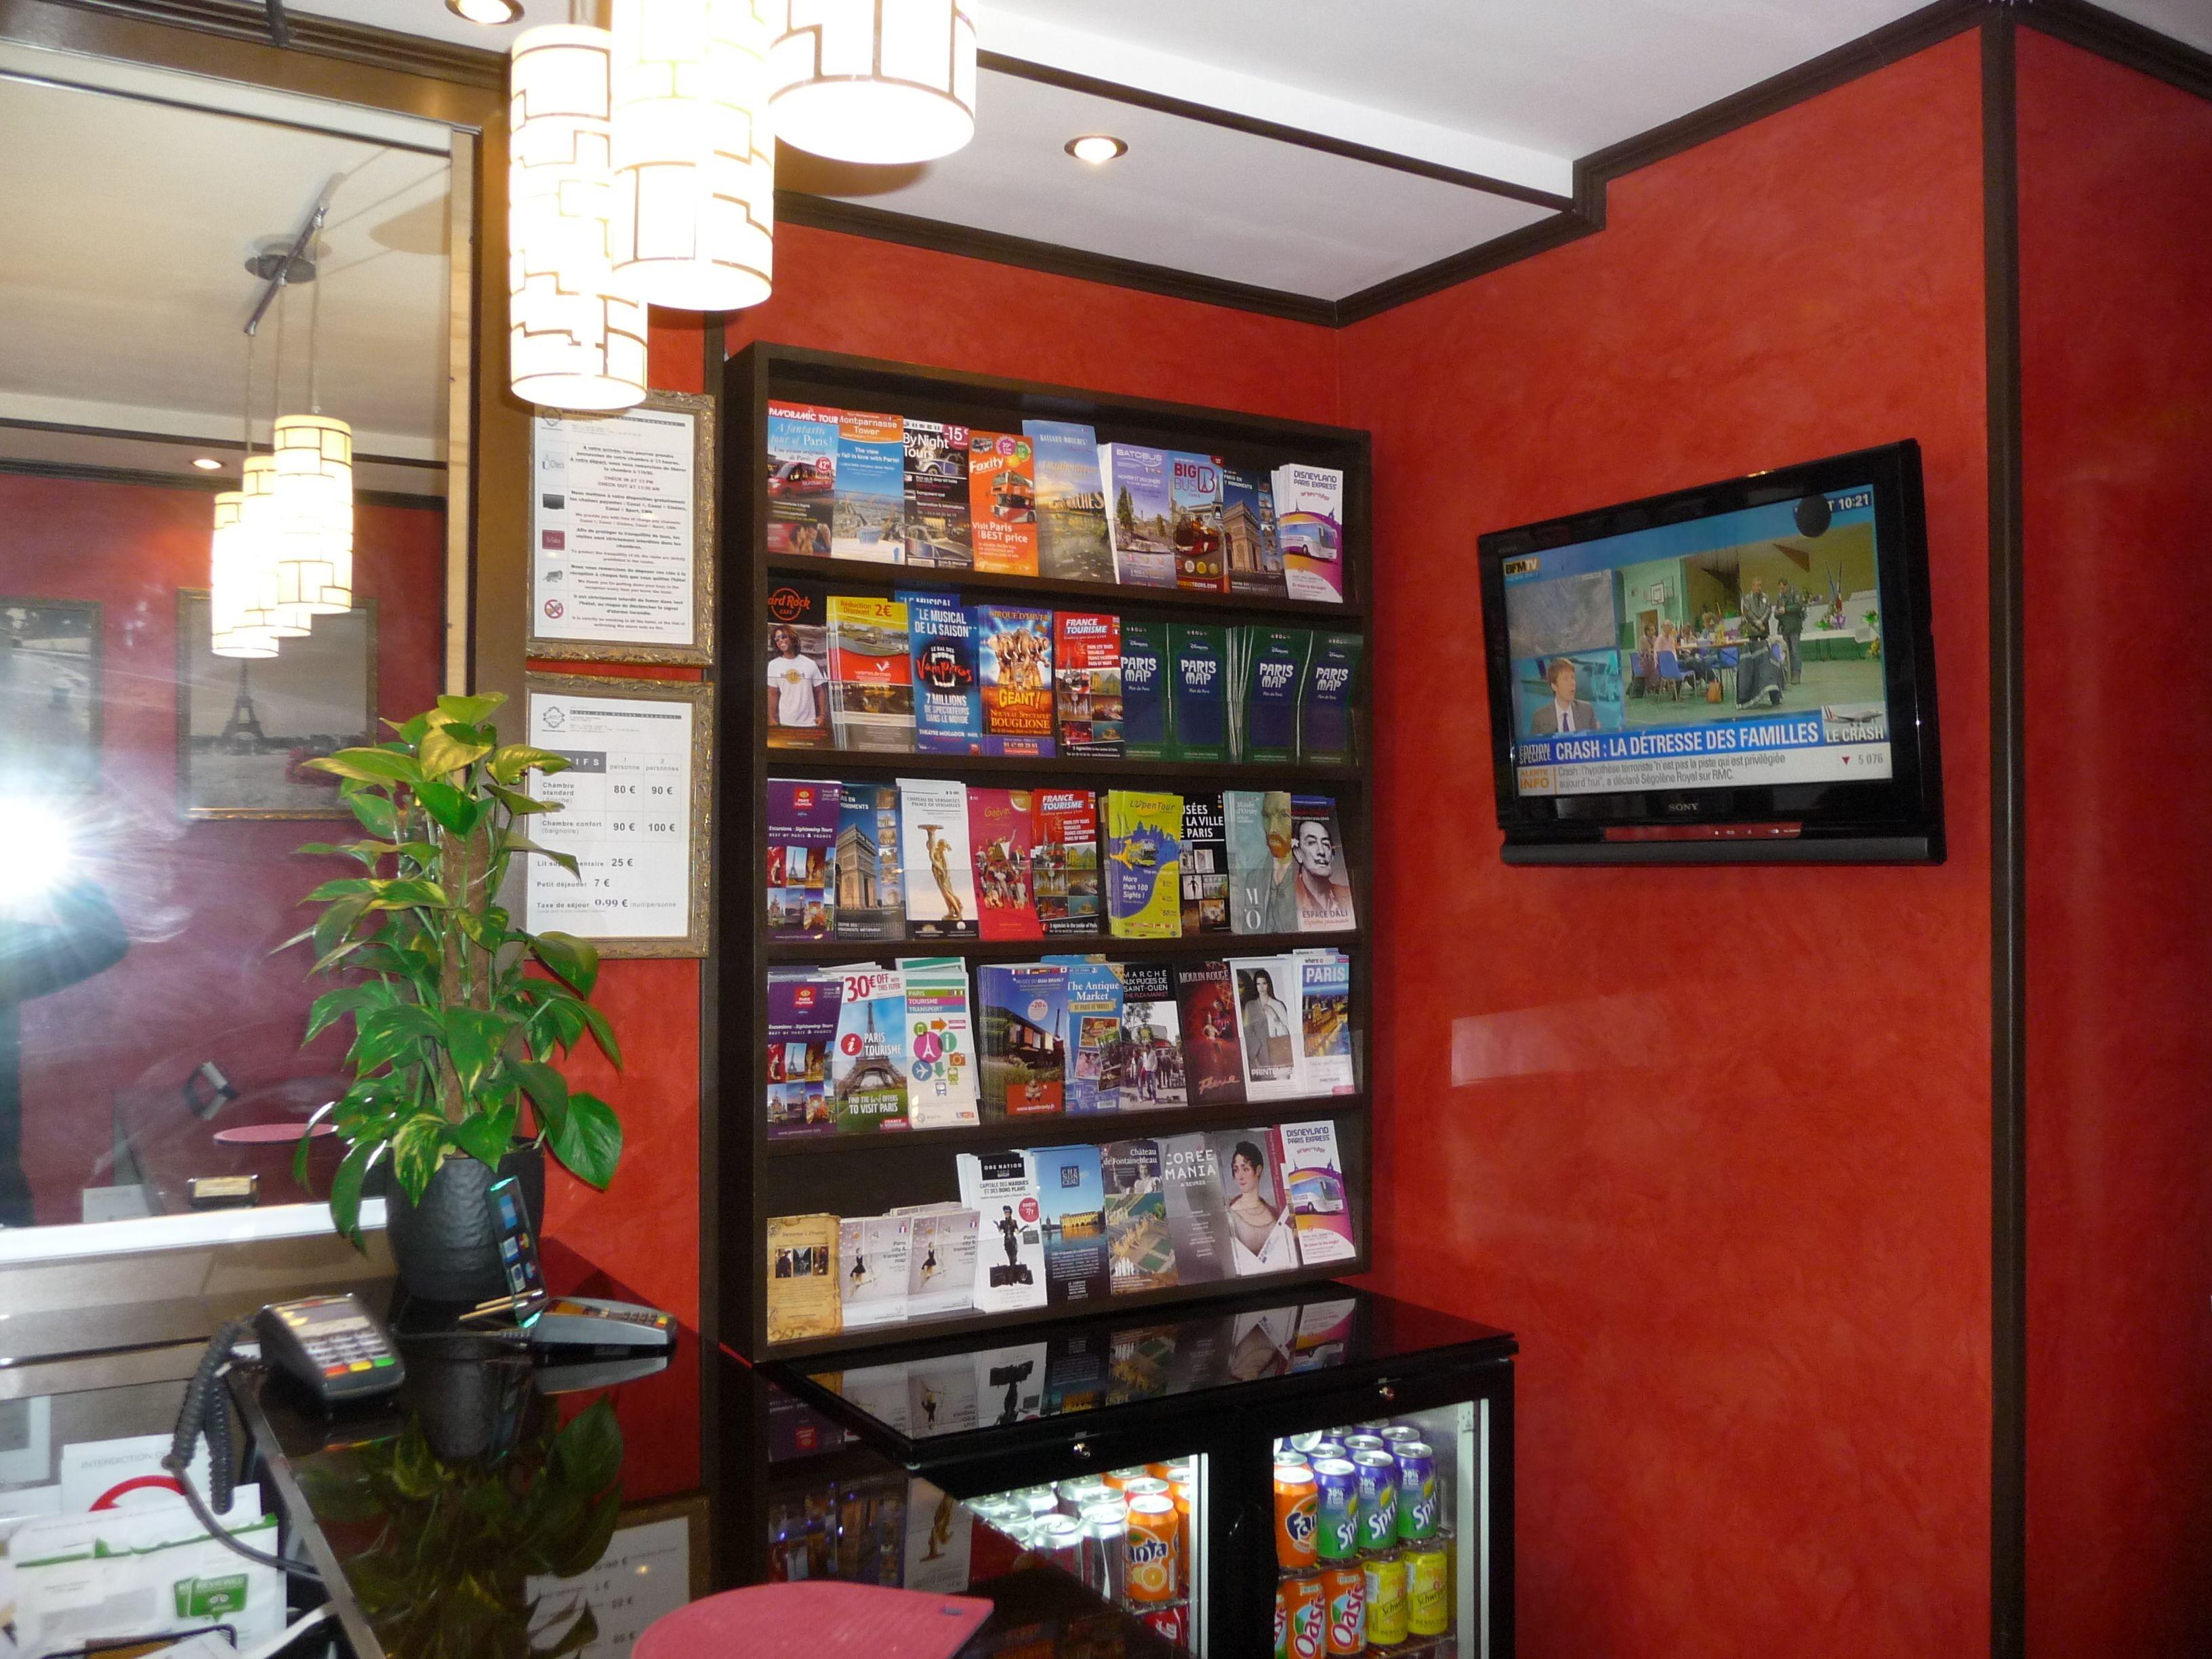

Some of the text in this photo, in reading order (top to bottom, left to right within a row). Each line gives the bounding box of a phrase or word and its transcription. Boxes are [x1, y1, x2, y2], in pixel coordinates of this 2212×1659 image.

[769, 407, 816, 421] PANORAMIC
[819, 414, 839, 424] TOUR
[786, 425, 825, 436] fantastic
[854, 426, 880, 435] Tower
[771, 434, 827, 447] tour Paris
[903, 432, 917, 448] By
[918, 434, 949, 449] Night
[904, 447, 934, 459] Tours
[1116, 449, 1162, 462] BATOBUS
[970, 457, 1004, 472] Foxity
[1174, 462, 1197, 478] BIG
[1294, 470, 1337, 483] DISNEYLAND
[1174, 478, 1197, 492] BUS
[1294, 479, 1337, 490] PARIS EXPRESS
[1839, 493, 1868, 510] 10:21
[972, 521, 1012, 532] Visit Paris
[981, 531, 1028, 543] BEST price
[787, 596, 811, 611] Rock
[840, 600, 872, 610] Réduction
[843, 607, 870, 615] Discount
[875, 605, 892, 617] 2€
[989, 610, 1018, 621] CIRQUE
[930, 611, 966, 625] MUSICAL
[915, 621, 925, 633] DE
[927, 623, 937, 634] LA
[1067, 626, 1107, 634] TOURISME
[917, 653, 972, 683] Vampires
[1120, 656, 1157, 672] PARIS
[1181, 659, 1216, 674] PARIS
[1125, 669, 1151, 682] MAP
[1260, 663, 1294, 678] PARIS
[1315, 667, 1348, 681] PARIS
[1186, 672, 1211, 685] MAP
[1262, 675, 1286, 689] MAP
[1317, 679, 1341, 692] MAP
[926, 693, 966, 705] 7 MILLIONS
[932, 705, 969, 715] SPECTATEURS
[926, 714, 968, 724] DANS LE MONDE
[991, 717, 1050, 729] BOUGLIONE
[939, 729, 965, 737] MOGADOR
[1826, 726, 1884, 742] LE CRASH
[1556, 722, 1818, 761] CRASH LA DÉTRESSE DES FAMILLES
[1675, 756, 1742, 771] pas la piste qui est
[1677, 771, 1697, 783] Royal
[1713, 769, 1734, 781] RMC.
[613, 785, 636, 794] 80 €
[1519, 778, 1549, 790] INFO
[651, 786, 663, 795] 90
[1042, 794, 1074, 802] FRANCE
[1043, 800, 1083, 811] TOURISME
[1182, 802, 1208, 815] SÉES
[1668, 803, 1699, 812] SONY
[613, 823, 635, 831] 90 €
[649, 823, 675, 832] 100 €
[1187, 817, 1223, 826] LA VILLE
[1187, 828, 1213, 838] PARIS
[611, 859, 633, 867] 25 €
[594, 879, 599, 887] 7
[604, 879, 610, 887] €
[1123, 875, 1137, 883] More
[1123, 891, 1141, 899] Sights
[1246, 888, 1259, 905] M
[622, 899, 628, 907] €
[1303, 910, 1328, 918] ESPACE
[1180, 970, 1229, 983] MOULIN ROUGE
[1306, 966, 1345, 983] PARIS
[845, 973, 889, 1002] 30€ OFF
[878, 982, 900, 991] THIS FLYER
[1068, 982, 1119, 993] The Antique
[1077, 991, 1109, 1001] Market
[864, 1032, 885, 1044] PARIS
[864, 1044, 901, 1055] TOURISME
[1251, 1068, 1293, 1076] PRINTEMPS
[849, 1096, 859, 1104] FIND
[849, 1103, 897, 1114] TO VISIT PARIS
[1286, 1126, 1329, 1137] DISNEYLAND
[1305, 1134, 1330, 1143] EXPRESS
[1113, 1156, 1158, 1164] Fontainebleau
[1165, 1165, 1216, 1181] MANIA
[81, 1452, 152, 1469] INTERDICTION
[1359, 1477, 1375, 1487] 30%
[1328, 1488, 1344, 1498] 30%
[1368, 1494, 1398, 1540] Sprit
[1286, 1511, 1317, 1541] Fan
